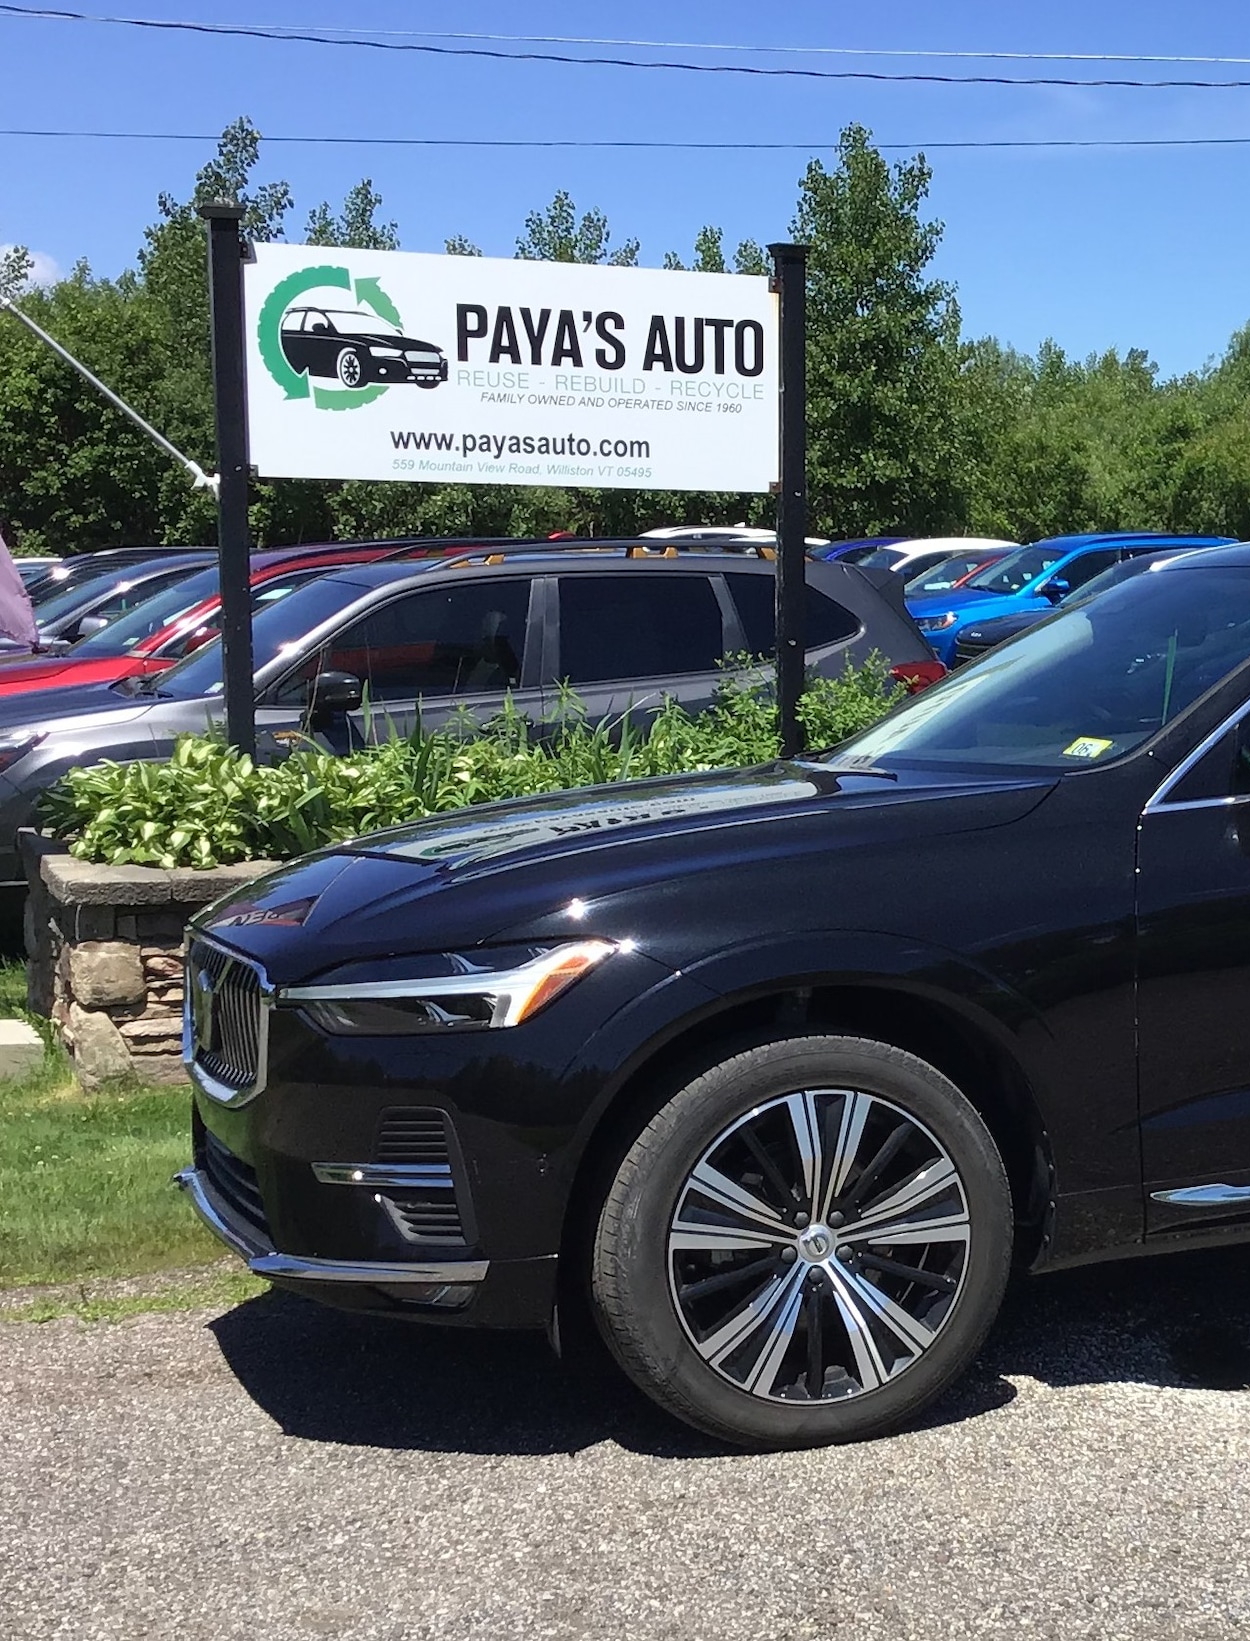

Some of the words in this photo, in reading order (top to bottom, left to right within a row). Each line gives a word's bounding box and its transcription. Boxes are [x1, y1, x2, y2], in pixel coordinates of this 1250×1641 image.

[456, 303, 626, 371] PAYA'S
[642, 314, 764, 377] AUTO
[456, 369, 530, 389] REUSE
[555, 374, 646, 395] REBUILD
[670, 379, 764, 400] RECYCLE
[480, 391, 525, 405] FAMILY
[527, 393, 576, 407] OWNED
[578, 396, 605, 408] AND
[607, 397, 673, 411] OPERATED
[676, 400, 713, 413] SINCE
[716, 402, 743, 414] 1960
[389, 430, 650, 460] www.payasauto.com
[391, 458, 415, 470] 559
[418, 459, 474, 472] Mountain
[477, 461, 506, 473] View
[546, 463, 595, 477] Williston
[597, 465, 615, 477] VT
[616, 466, 653, 478] 05495
